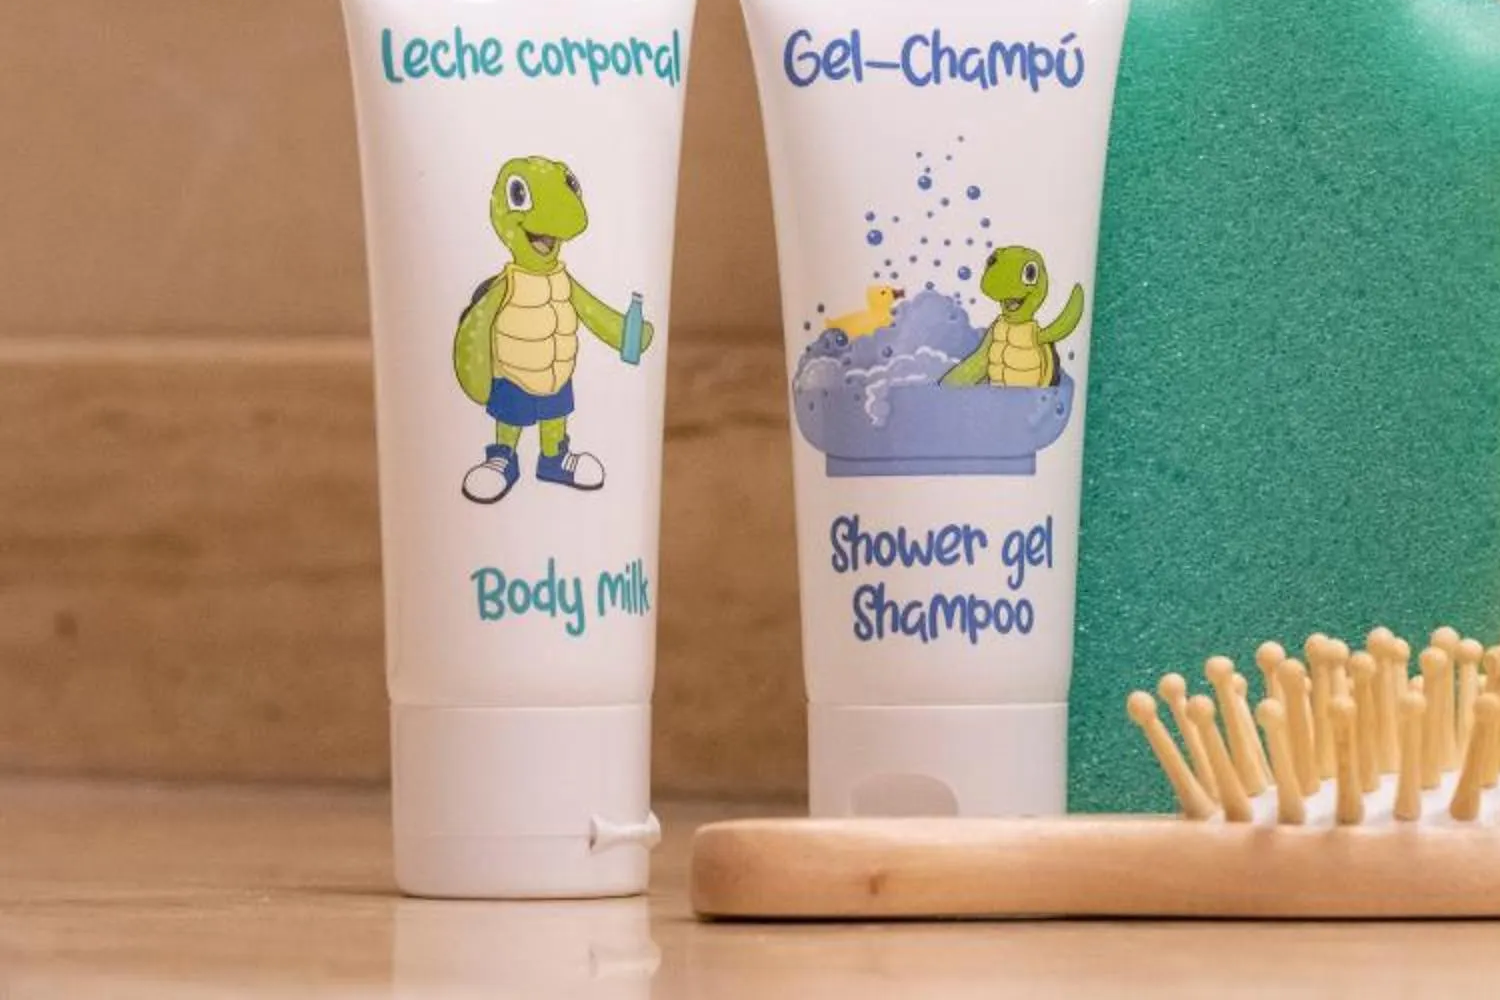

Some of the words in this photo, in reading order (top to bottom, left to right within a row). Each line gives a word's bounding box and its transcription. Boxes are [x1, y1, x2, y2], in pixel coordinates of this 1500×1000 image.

[381, 26, 505, 84] Leche
[515, 28, 682, 88] corporal
[829, 513, 990, 574] Shower
[1000, 514, 1055, 592] gel
[470, 556, 587, 638] Body
[851, 580, 1035, 645] Shampoo
